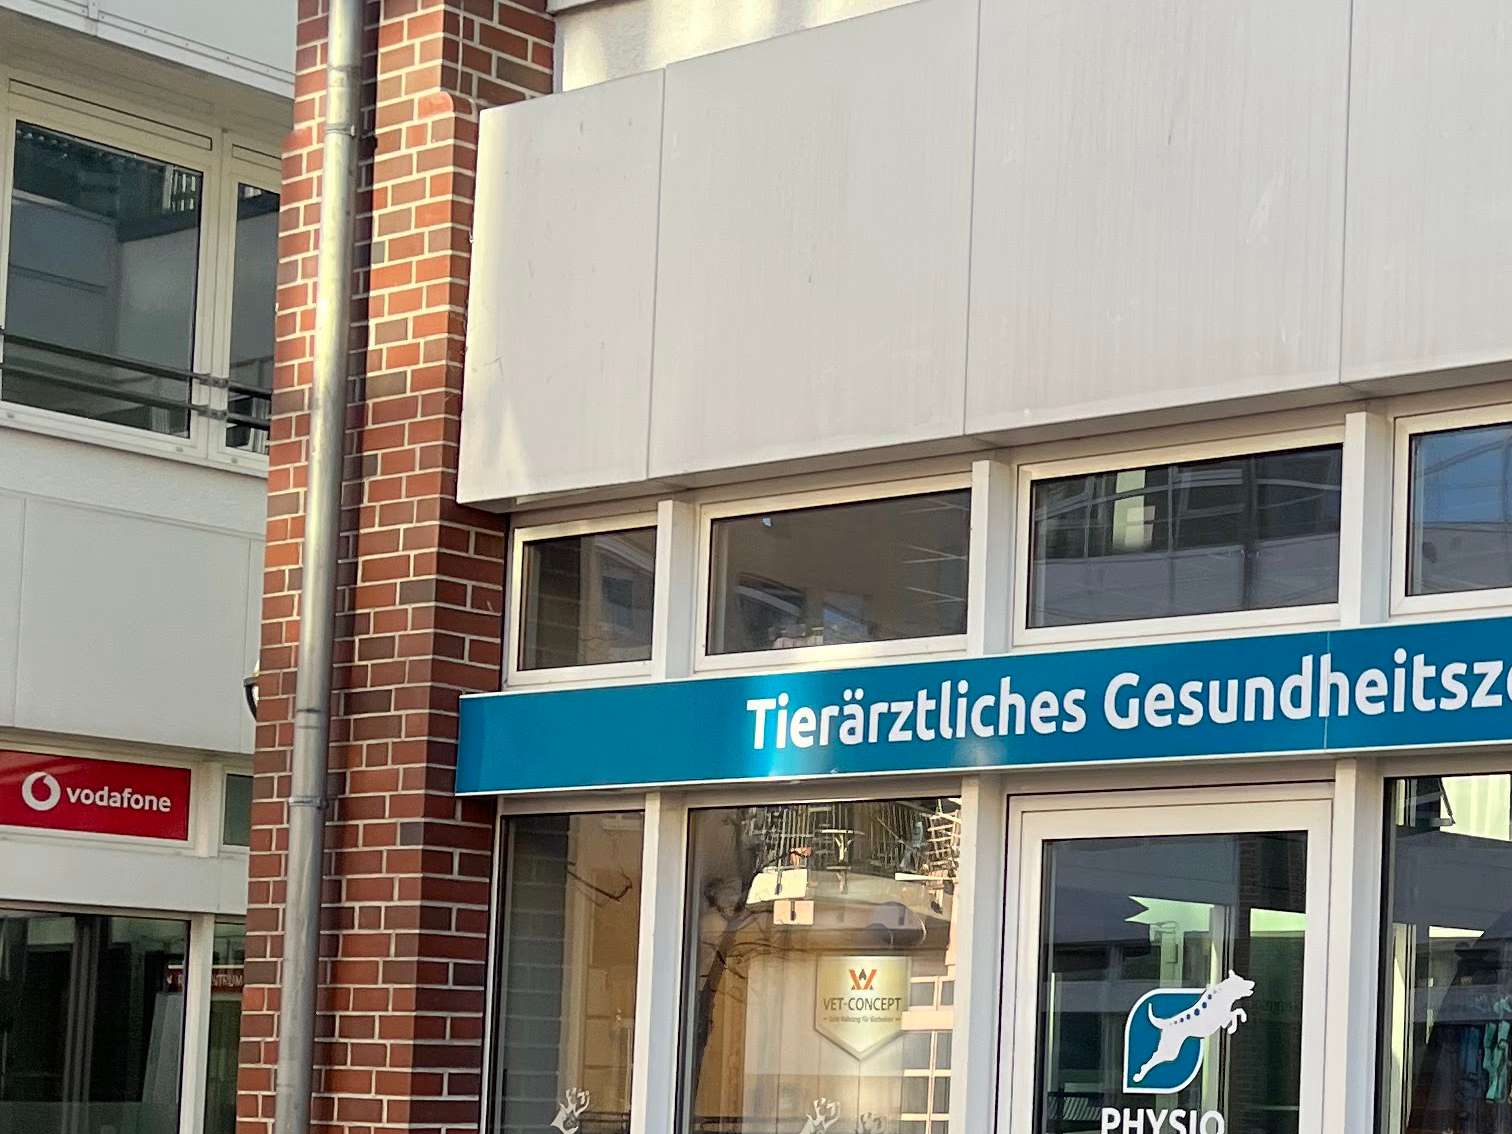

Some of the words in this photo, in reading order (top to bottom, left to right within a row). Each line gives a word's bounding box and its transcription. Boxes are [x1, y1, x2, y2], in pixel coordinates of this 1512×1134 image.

[746, 676, 1087, 752] Tierärztliches
[66, 785, 172, 812] vodafone
[823, 996, 903, 1012] VET-CONCEPT
